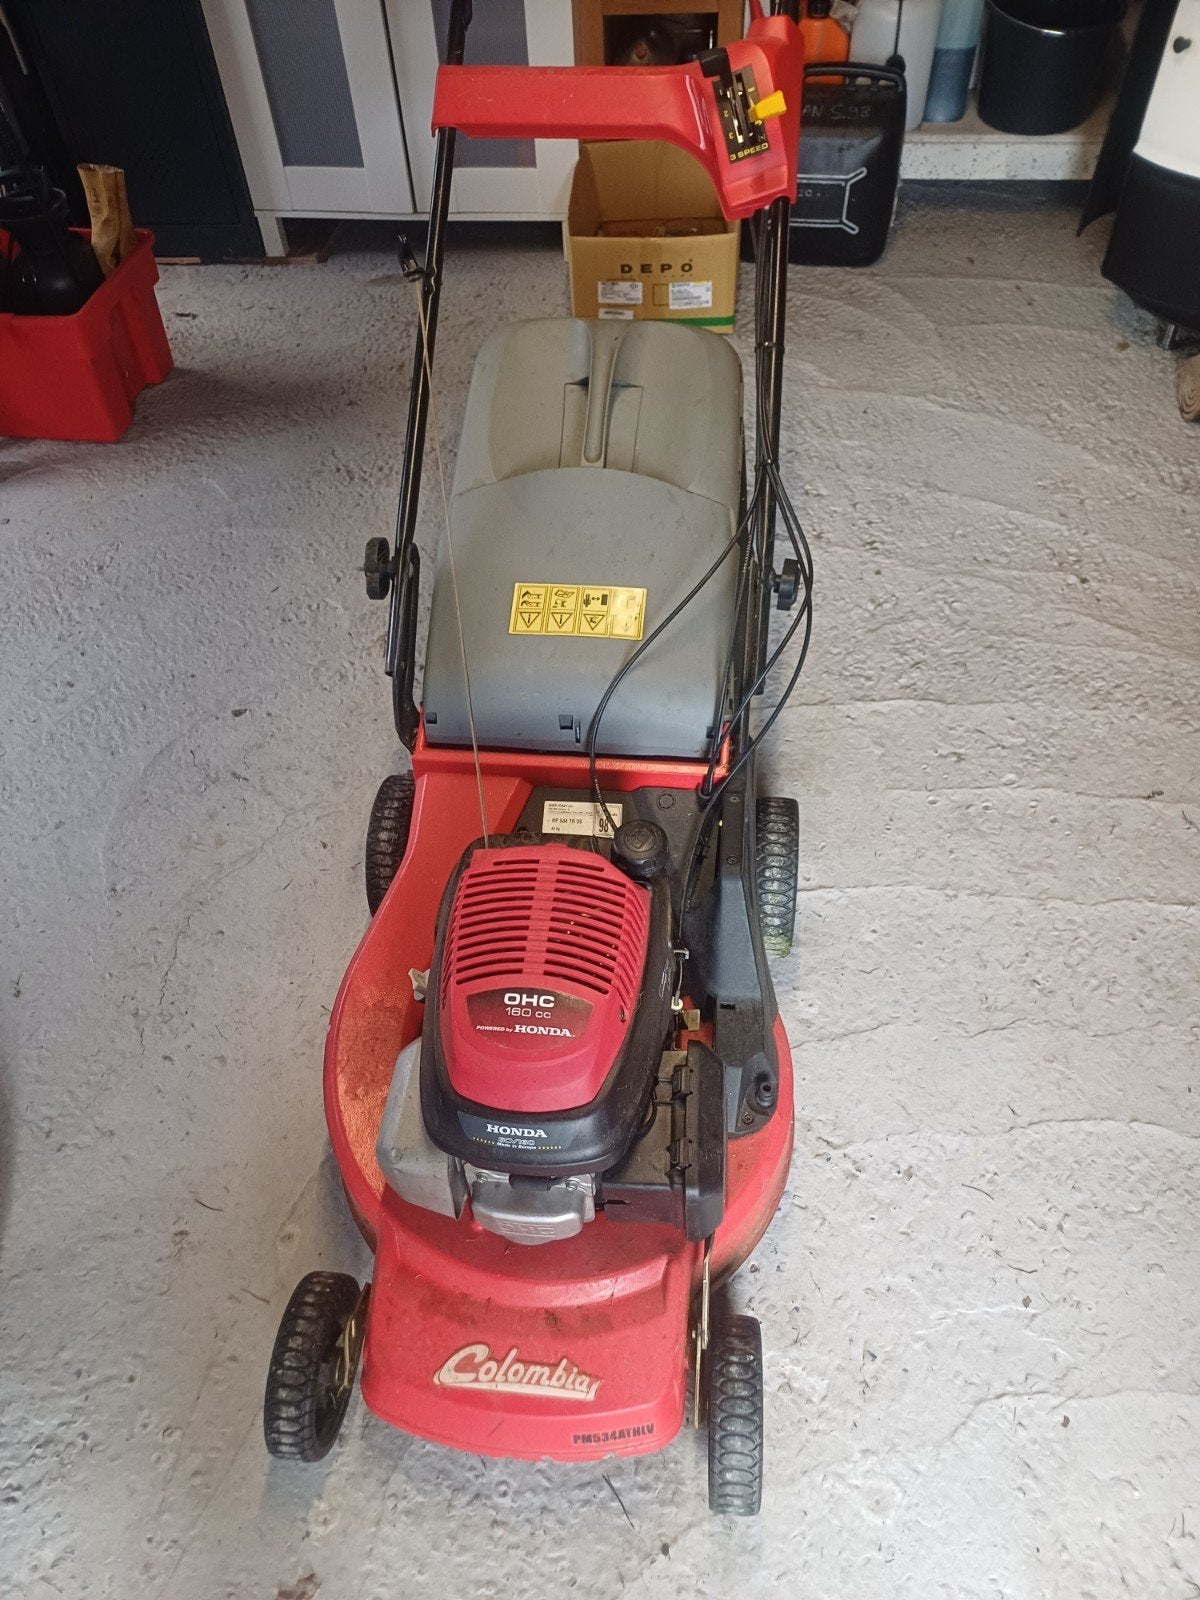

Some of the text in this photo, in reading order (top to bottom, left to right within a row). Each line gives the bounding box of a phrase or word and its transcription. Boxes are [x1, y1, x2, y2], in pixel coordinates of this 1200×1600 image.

[737, 142, 769, 158] SPEED
[620, 262, 693, 274] DEPO
[503, 993, 555, 1008] OHC
[505, 1007, 552, 1019] 160 cc
[514, 1024, 573, 1037] HONDA
[486, 1123, 548, 1138] HONDA
[434, 1344, 599, 1400] Colombia
[573, 1423, 655, 1445] PM534ATHLV
